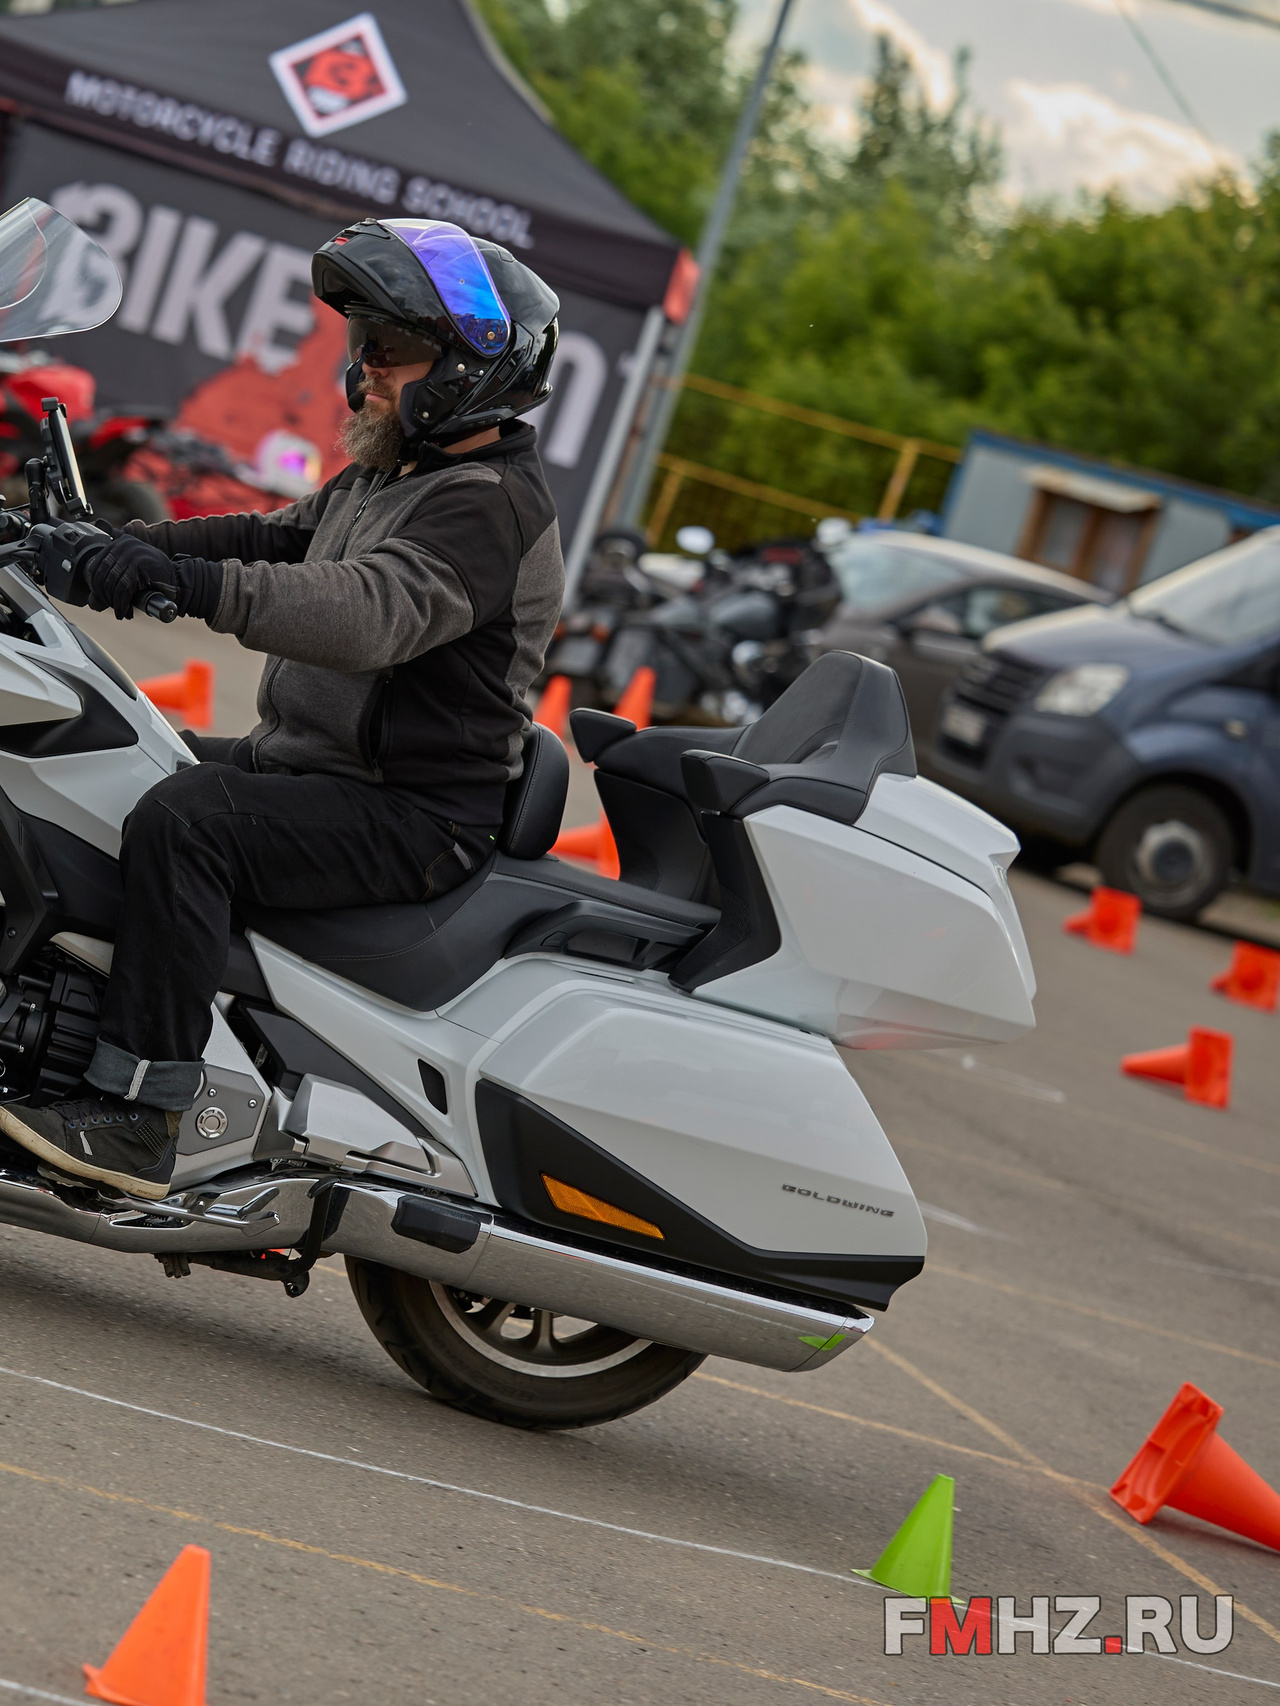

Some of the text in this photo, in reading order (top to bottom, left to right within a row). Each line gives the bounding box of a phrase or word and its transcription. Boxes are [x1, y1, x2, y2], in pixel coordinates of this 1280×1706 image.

[65, 69, 535, 250] MOTORCYCLE RIDING SCHOOL
[38, 178, 315, 376] BIKE
[781, 1183, 895, 1218] GOLDWING
